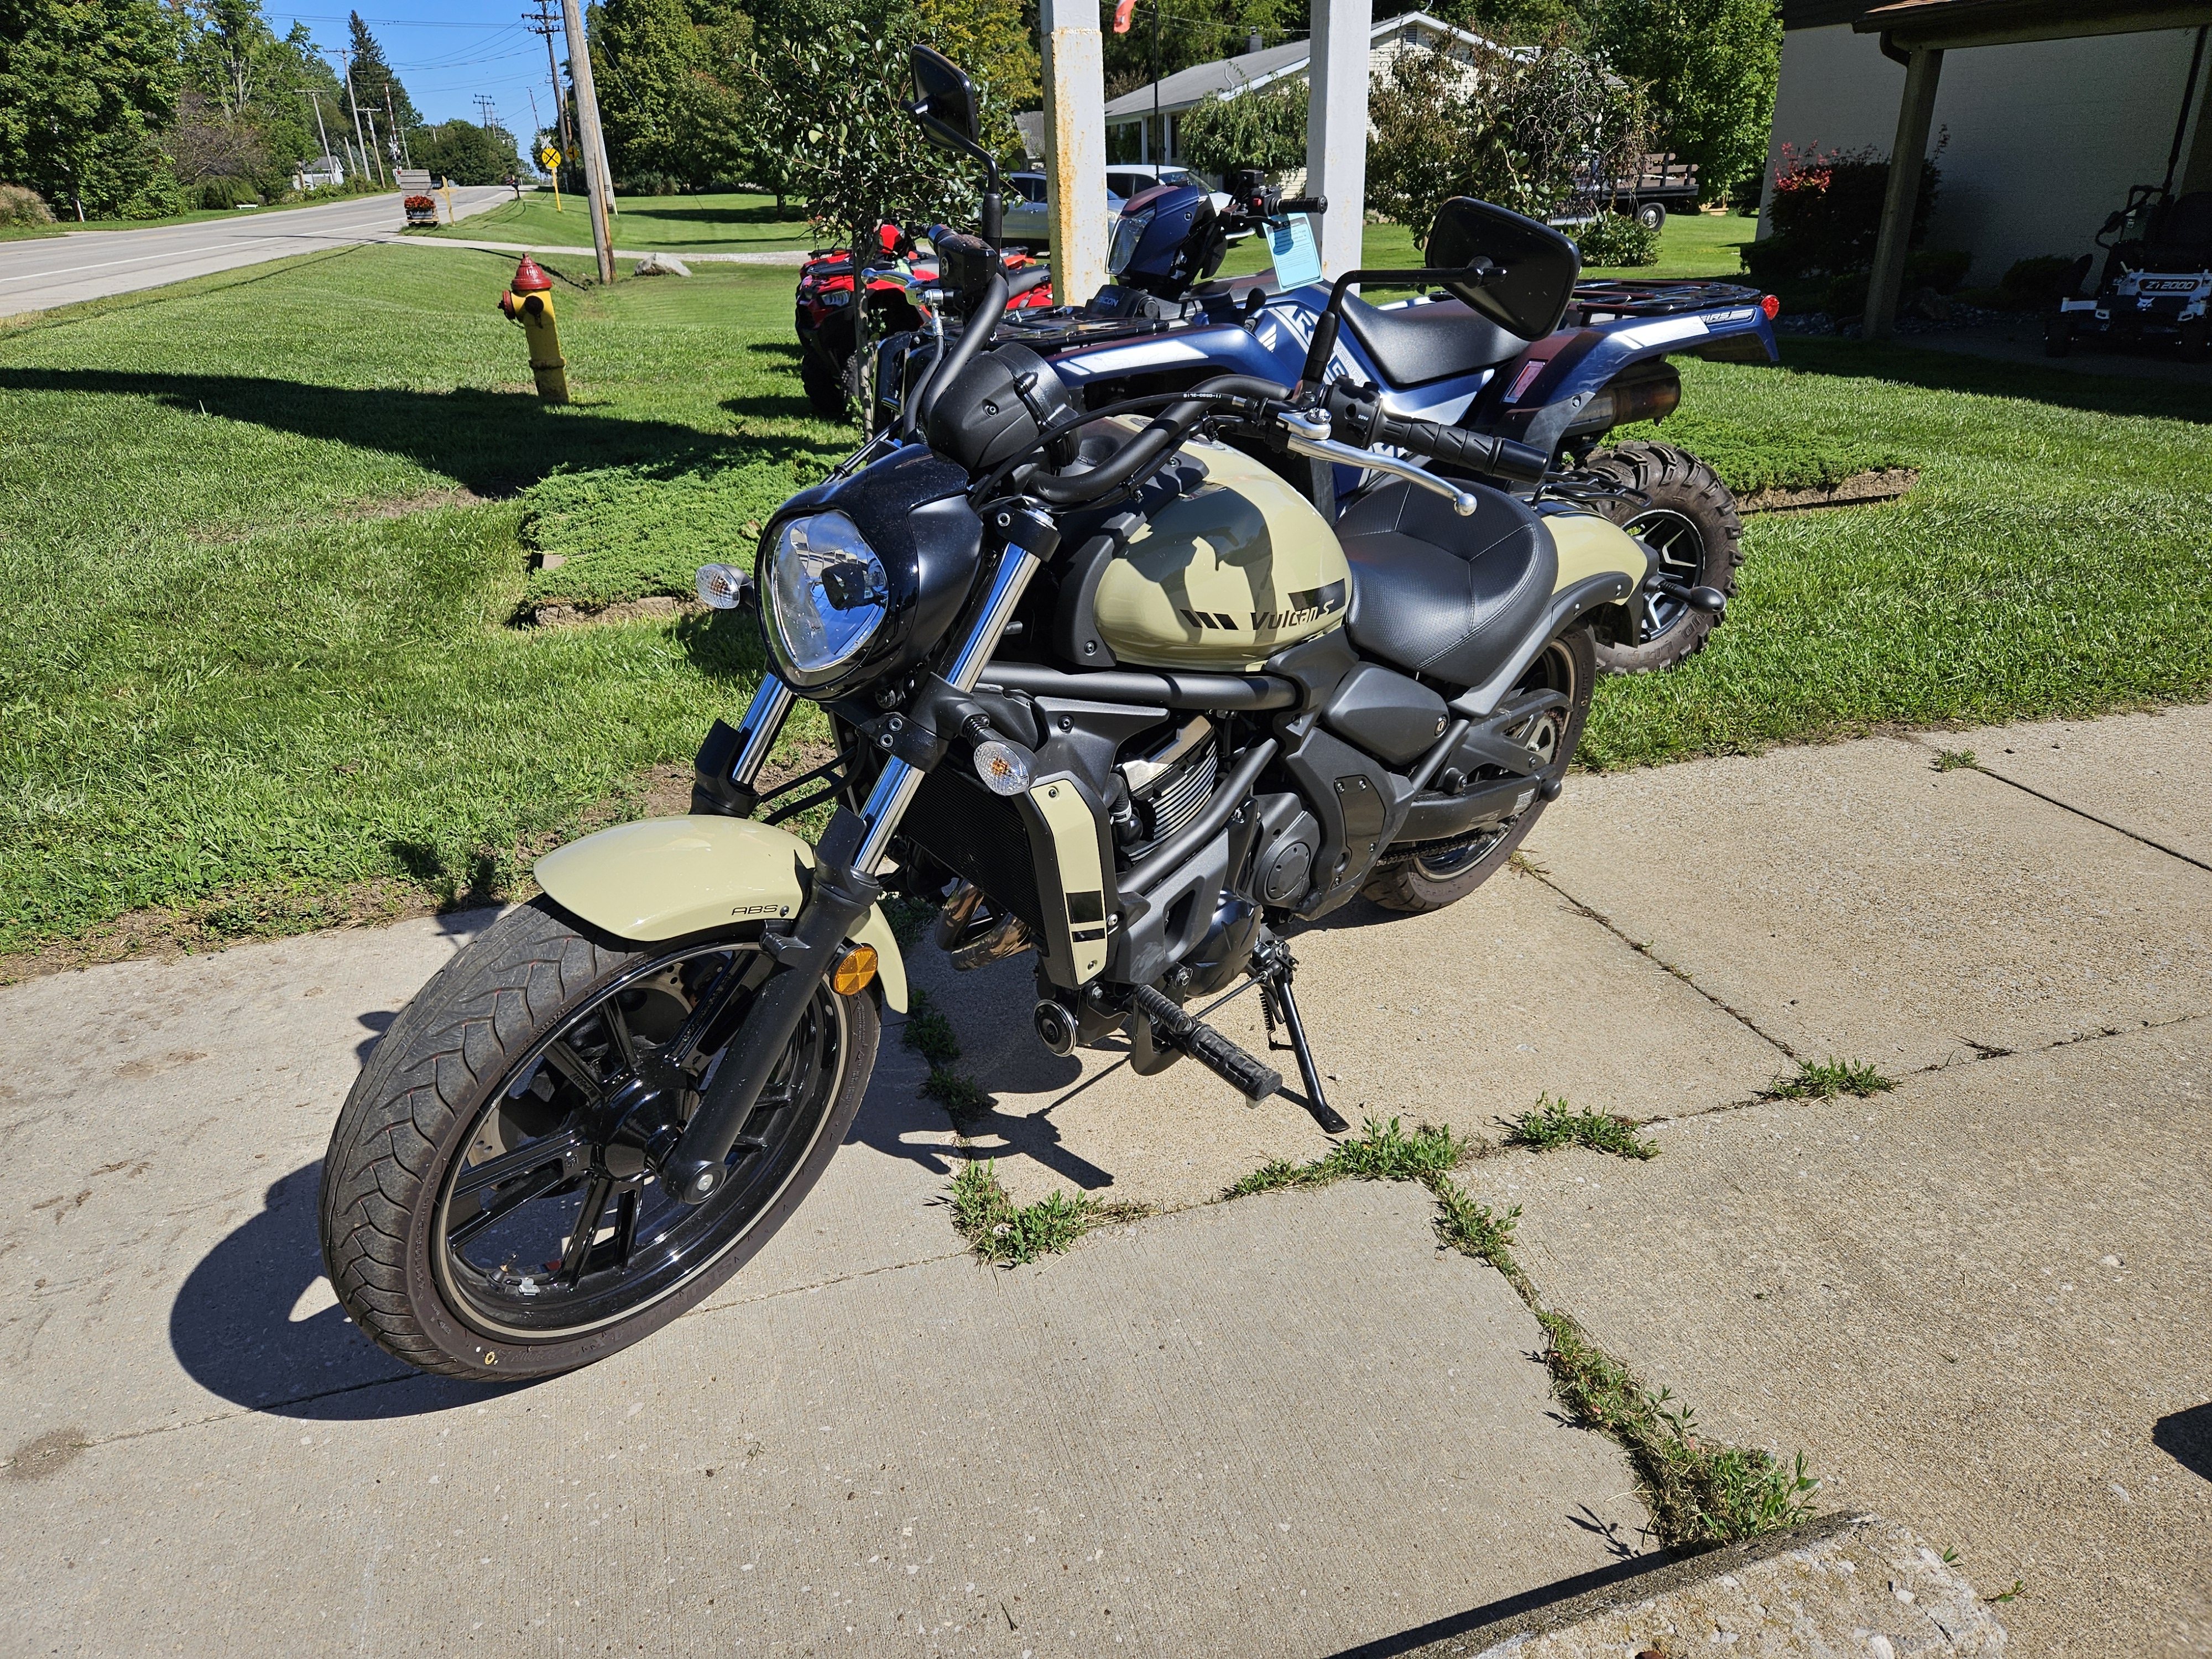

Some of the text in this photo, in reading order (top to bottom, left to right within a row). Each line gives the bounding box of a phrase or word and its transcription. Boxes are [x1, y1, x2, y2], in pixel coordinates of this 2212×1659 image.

[1706, 312, 1731, 321] IRS
[1250, 599, 1334, 630] Vulcan S
[1626, 640, 1673, 664] LITE
[732, 905, 778, 915] ABS
